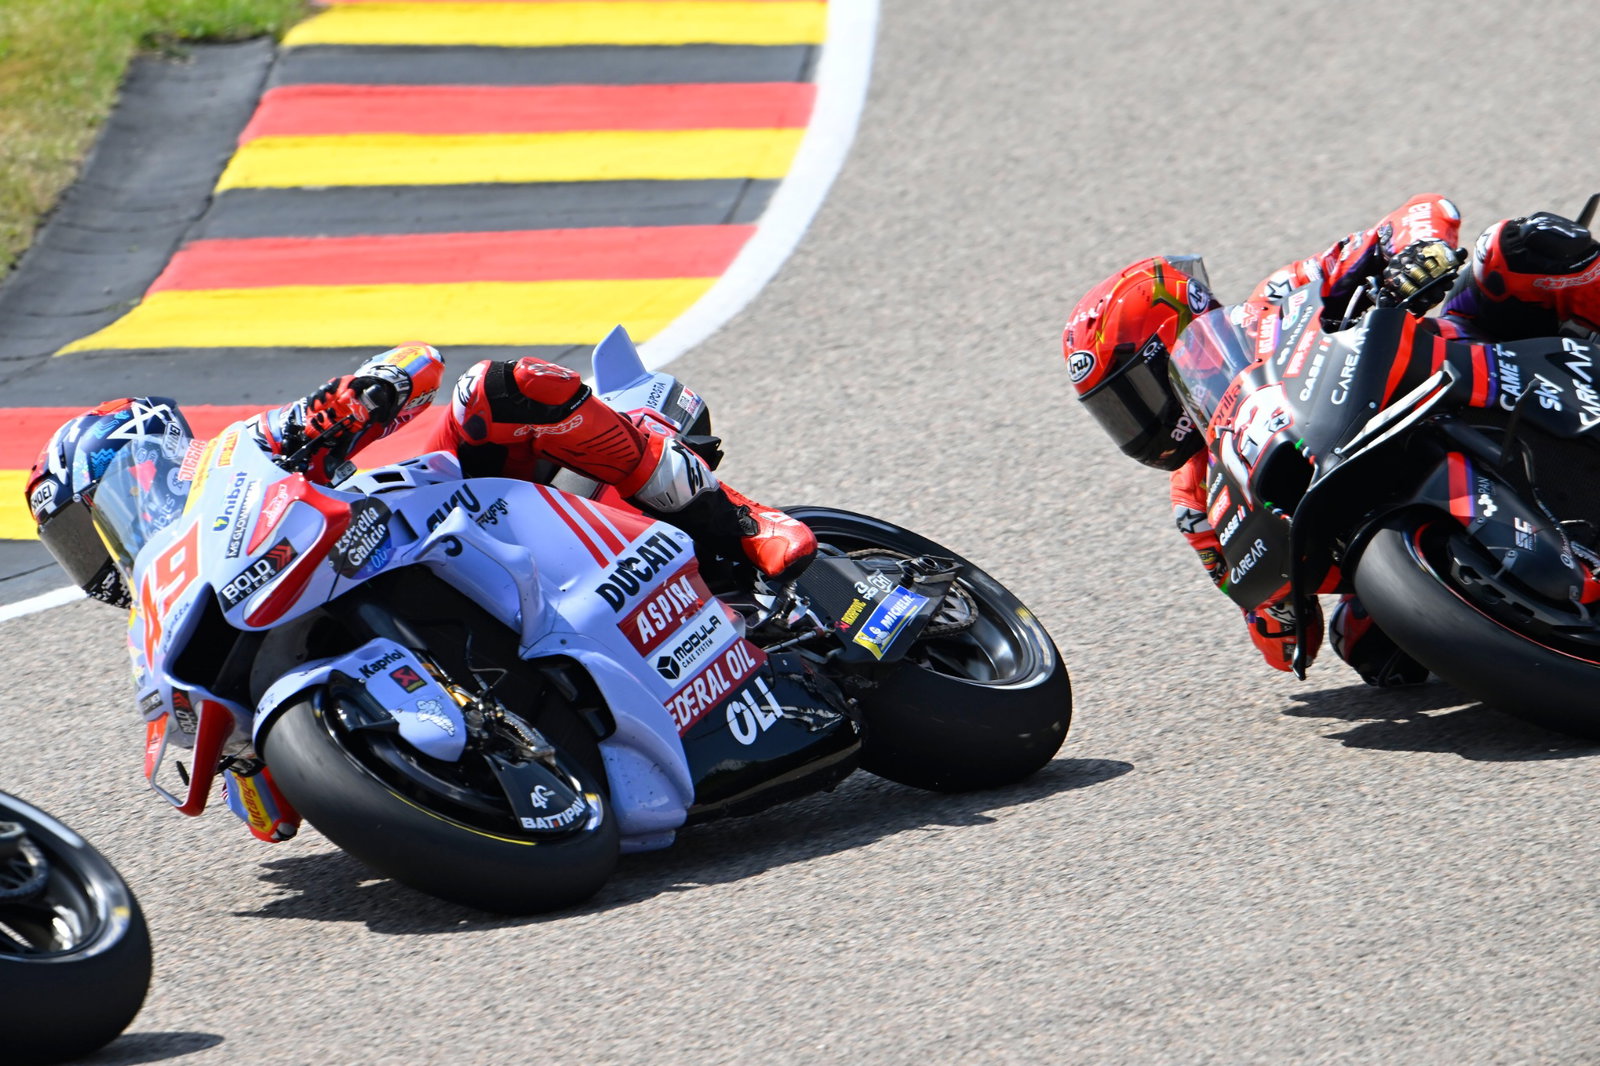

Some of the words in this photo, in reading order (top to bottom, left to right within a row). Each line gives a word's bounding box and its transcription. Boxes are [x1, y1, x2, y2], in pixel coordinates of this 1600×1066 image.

[1300, 353, 1325, 402] CASE
[348, 523, 387, 566] Galicia
[1220, 514, 1240, 547] CASE
[222, 559, 272, 600] BOLD
[595, 531, 683, 613] DUCATI
[636, 574, 699, 645] ASPIRA
[674, 614, 722, 662] MODULA
[358, 649, 406, 679] Kapriol
[665, 662, 731, 733] EDERAL
[725, 640, 756, 681] OIL
[726, 676, 784, 746] OLI
[520, 796, 587, 829] BATTIPAV
